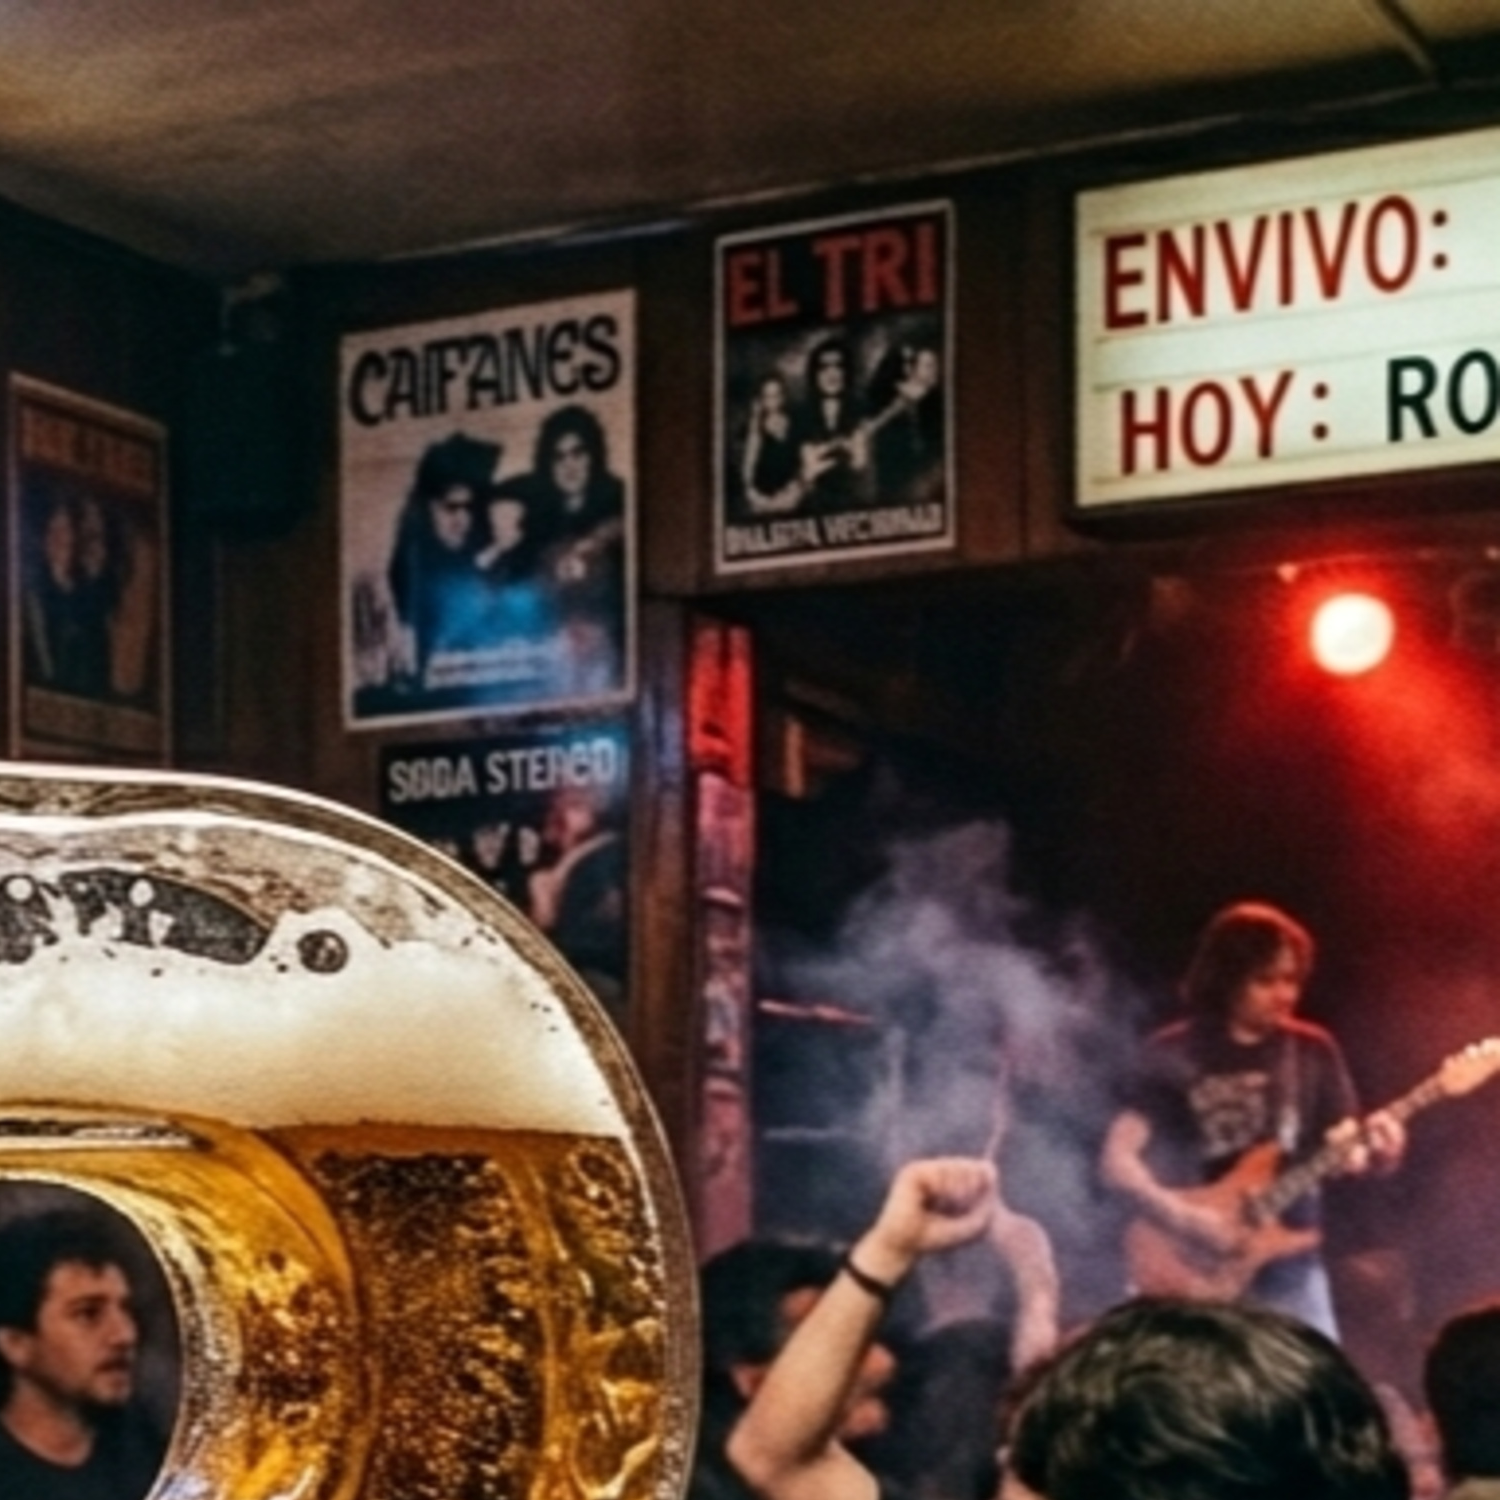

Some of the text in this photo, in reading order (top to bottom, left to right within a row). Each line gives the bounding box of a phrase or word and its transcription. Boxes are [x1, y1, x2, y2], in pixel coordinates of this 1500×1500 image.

[727, 222, 937, 326] EL TRI
[349, 313, 622, 427] CAIFANES
[1120, 369, 1330, 477] HOY:
